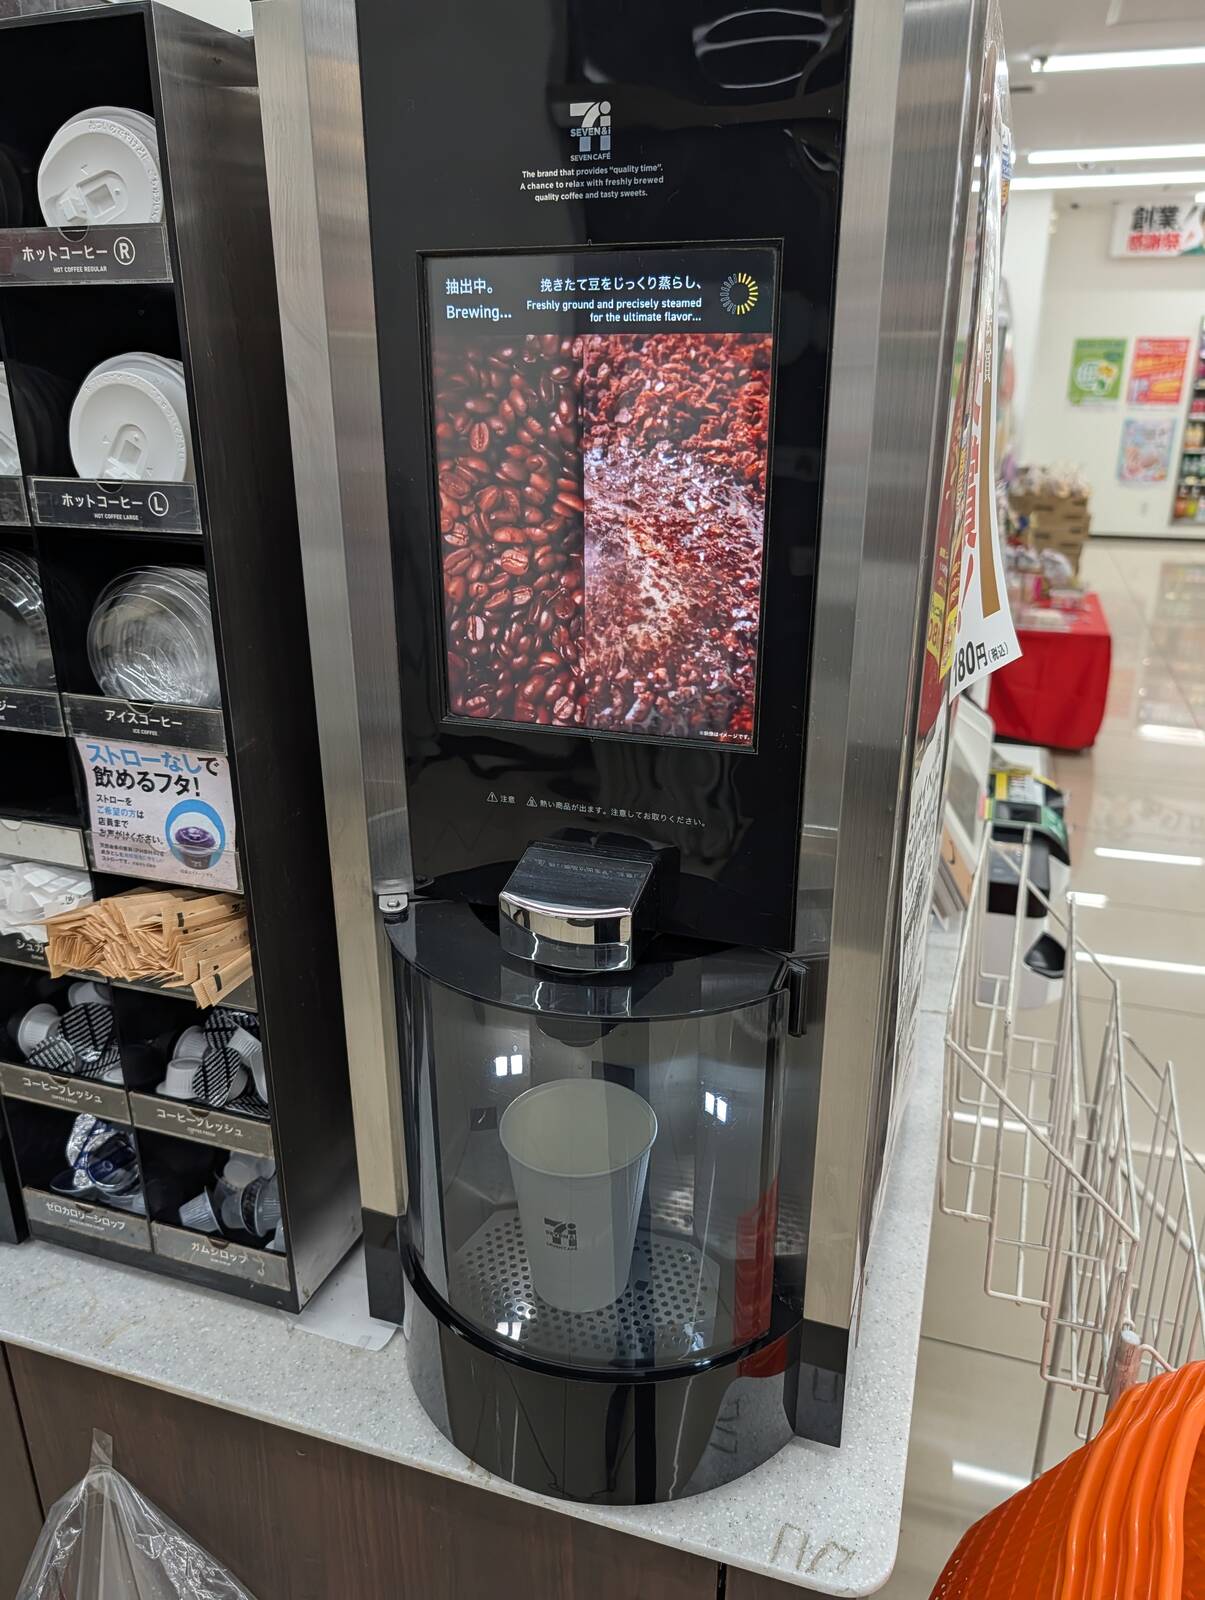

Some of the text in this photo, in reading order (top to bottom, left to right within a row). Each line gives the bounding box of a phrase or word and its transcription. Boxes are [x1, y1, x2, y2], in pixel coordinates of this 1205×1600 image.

[570, 152, 611, 162] SEVEN CAFÉ
[522, 171, 535, 179] The
[537, 169, 558, 178] brand
[559, 168, 575, 177] that
[576, 167, 608, 177] provides
[527, 181, 554, 190] chance
[565, 179, 585, 188] relax
[586, 178, 604, 187] with
[605, 177, 632, 187] freshly
[634, 176, 664, 185] brewed
[534, 189, 648, 202] quality coffee and tasty sweets.
[22, 245, 108, 262] ホットコーヒー
[446, 278, 493, 295] 抽出中。
[540, 276, 702, 293] 挽きたて豆をじっくり蒸らし、
[527, 297, 702, 311] Freshly ground and precisely steamed
[446, 305, 512, 321] Brewing...
[590, 311, 702, 322] for the ultimate flavor...
[62, 493, 143, 509] ホットコーヒー
[105, 710, 182, 727] アイスコーヒー
[86, 744, 219, 776] ストローなしで
[96, 794, 132, 806] ストローを
[98, 818, 128, 828] 店員まで
[16, 939, 44, 953] シュガ
[22, 1077, 102, 1103] コーヒーフレッシュ
[156, 1109, 243, 1136] コーヒーフレッシュ
[46, 1202, 125, 1229] ゼロカロリーシロップ
